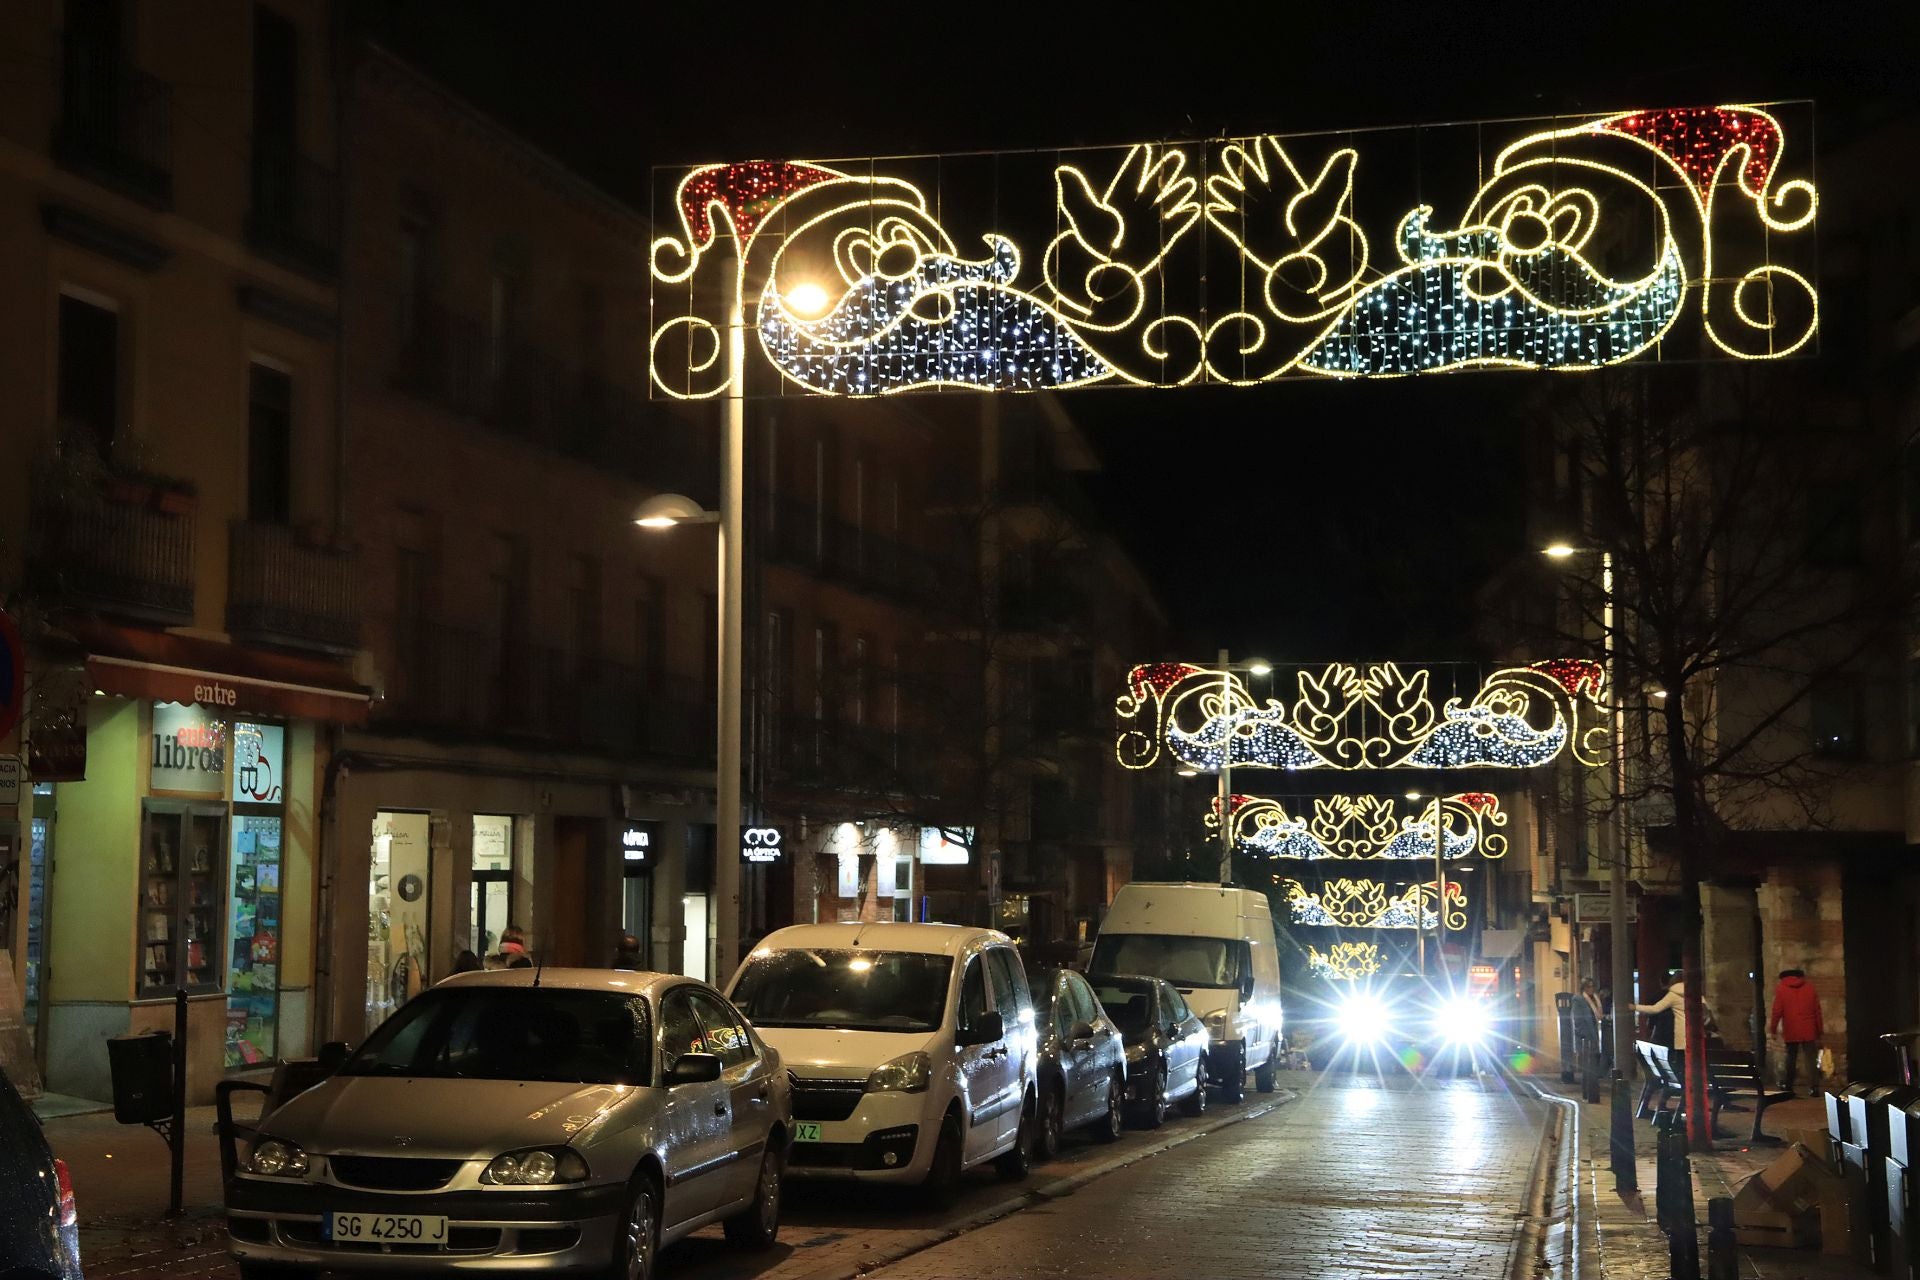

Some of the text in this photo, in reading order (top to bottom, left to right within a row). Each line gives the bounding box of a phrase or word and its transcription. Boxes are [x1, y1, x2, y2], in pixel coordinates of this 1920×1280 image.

[194, 683, 237, 706] entre
[798, 1124, 817, 1140] XZ
[337, 1216, 445, 1240] SG 4250 J
